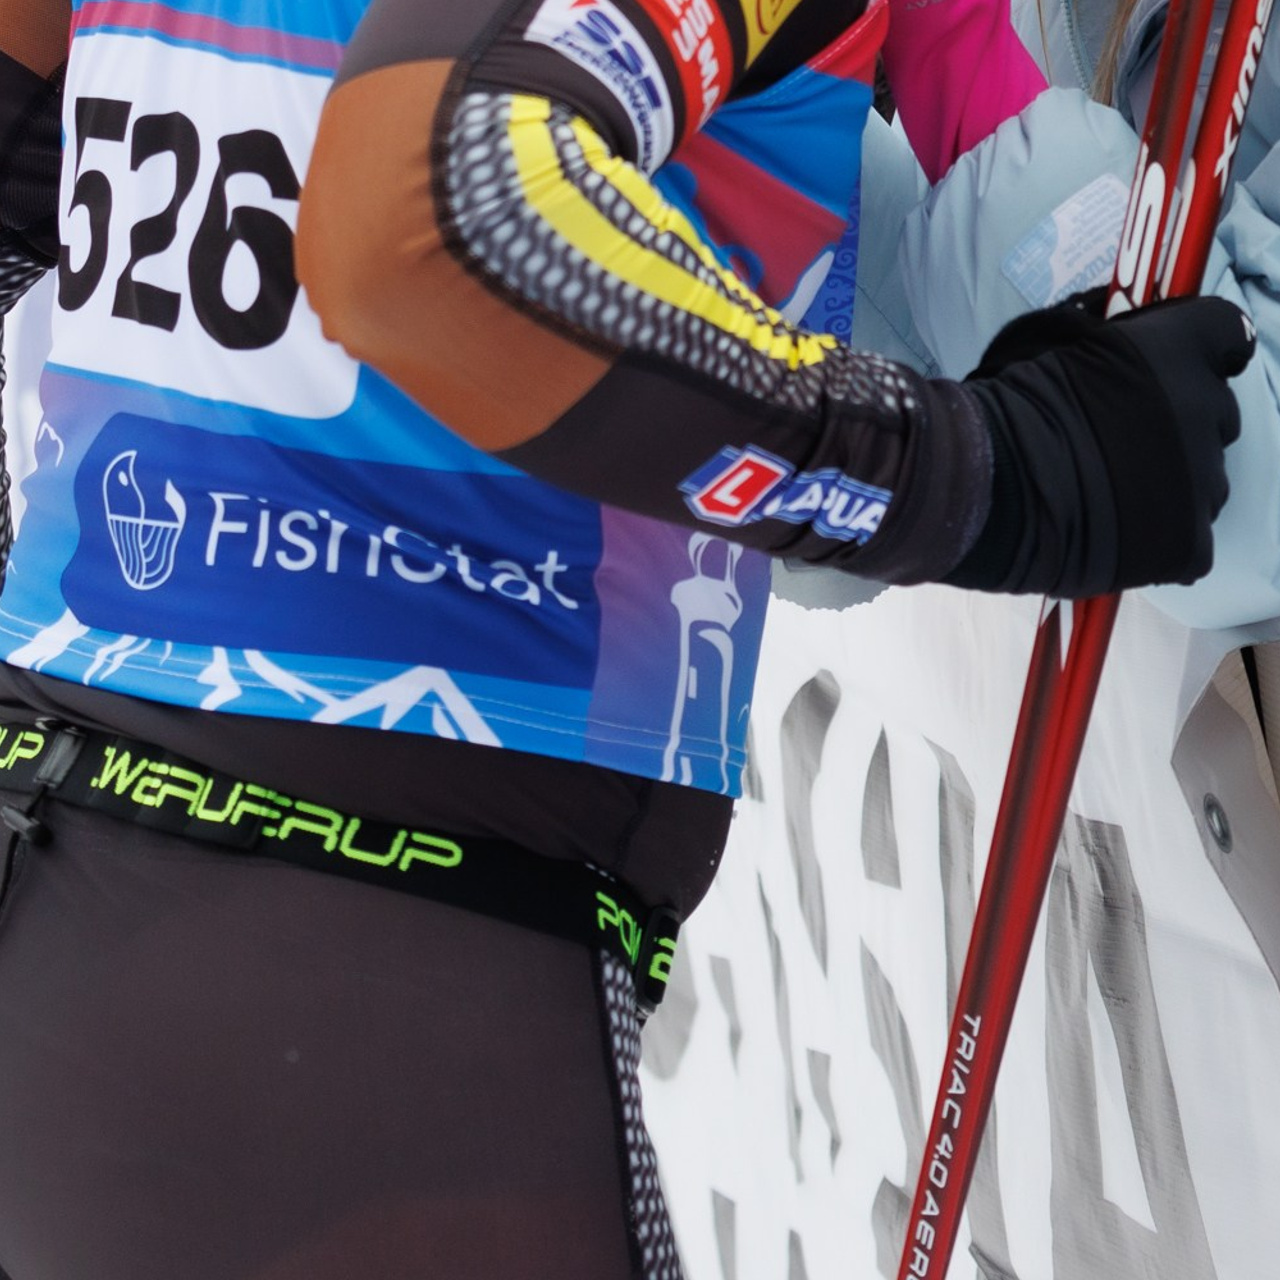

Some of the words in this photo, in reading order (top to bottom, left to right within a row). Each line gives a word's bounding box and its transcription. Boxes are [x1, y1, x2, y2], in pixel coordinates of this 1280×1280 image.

[58, 96, 302, 350] 526
[205, 491, 579, 609] FishStat
[941, 1013, 982, 1129] TRIAC
[928, 1133, 953, 1190] 4.0
